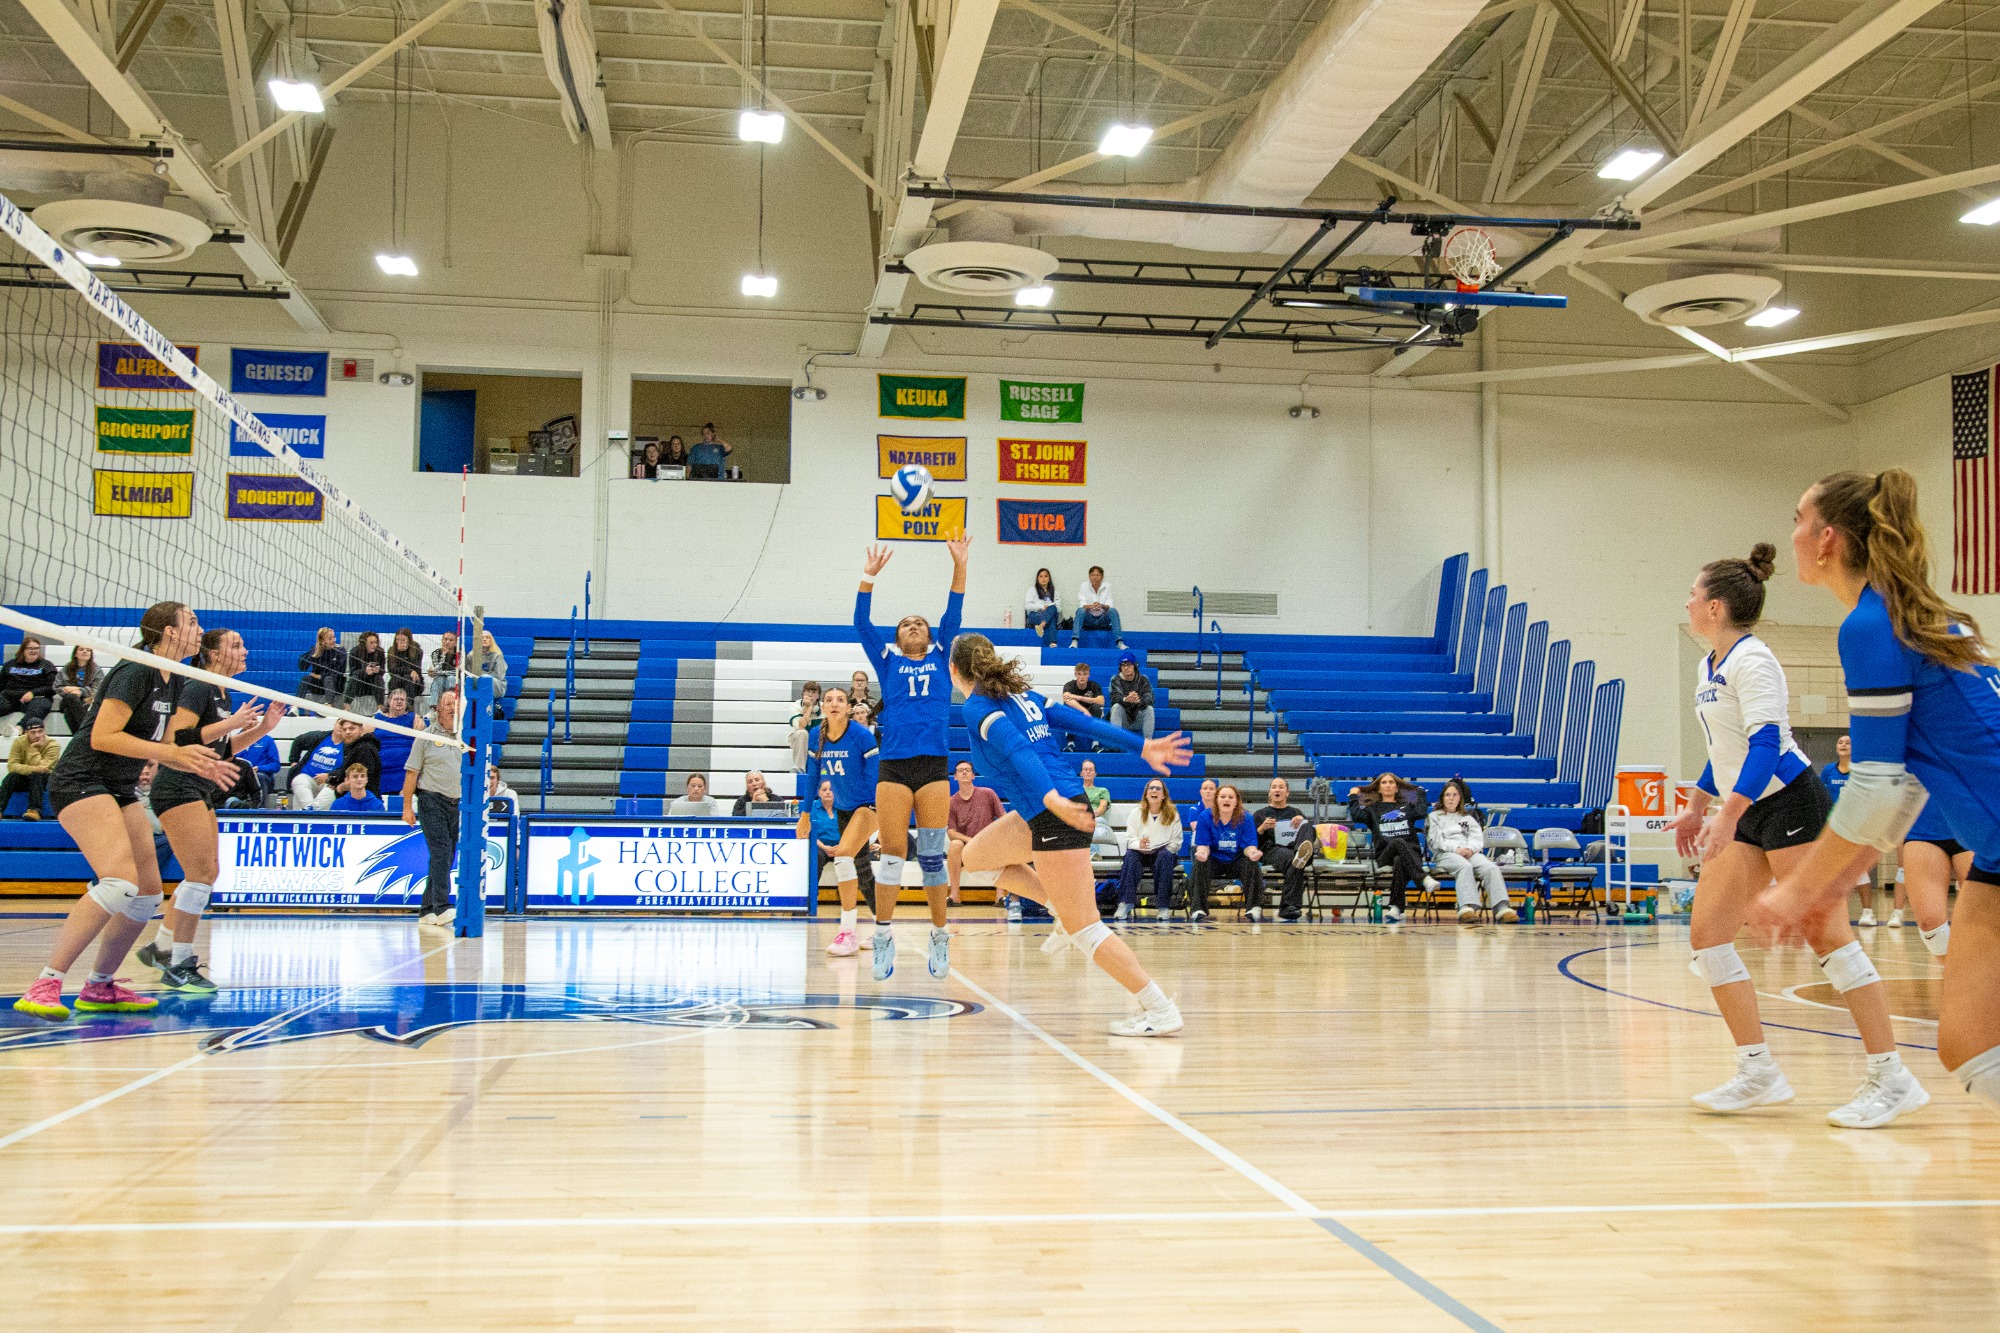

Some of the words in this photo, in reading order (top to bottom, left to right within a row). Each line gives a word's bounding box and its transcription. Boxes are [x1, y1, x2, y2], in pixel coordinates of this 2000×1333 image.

[115, 358, 178, 377] ALFRE
[245, 364, 314, 382] GENESEO
[896, 388, 948, 407] KEUKA
[1009, 385, 1075, 402] RUSSELL
[1020, 404, 1060, 419] SAGE
[100, 421, 189, 439] BROCKPORT
[889, 450, 956, 466] NAZARETH
[1010, 443, 1033, 460] ST.
[1035, 445, 1075, 461] JOHN
[1016, 464, 1069, 480] FISHER
[111, 485, 174, 503] ELMIRA
[237, 489, 315, 506] HOUGHTON
[903, 521, 939, 536] POLY
[1018, 514, 1066, 531] UTICA
[908, 674, 930, 697] 17
[1007, 691, 1043, 723] 16
[826, 760, 846, 776] 14
[1644, 781, 1659, 797] G
[223, 822, 273, 834] HOME
[293, 823, 313, 834] OF
[333, 824, 366, 835] THE
[642, 827, 729, 838] WELCOME
[749, 828, 768, 839] TO
[236, 836, 346, 868] HARTWICK
[617, 841, 789, 865] HARTWICK
[233, 869, 345, 892] HAWKS
[634, 869, 770, 893] COLLEGE
[222, 893, 360, 904] WWW.HARTWICKHAWKS.COM
[636, 896, 770, 906] #GREATDAYTOBEAHAWK
